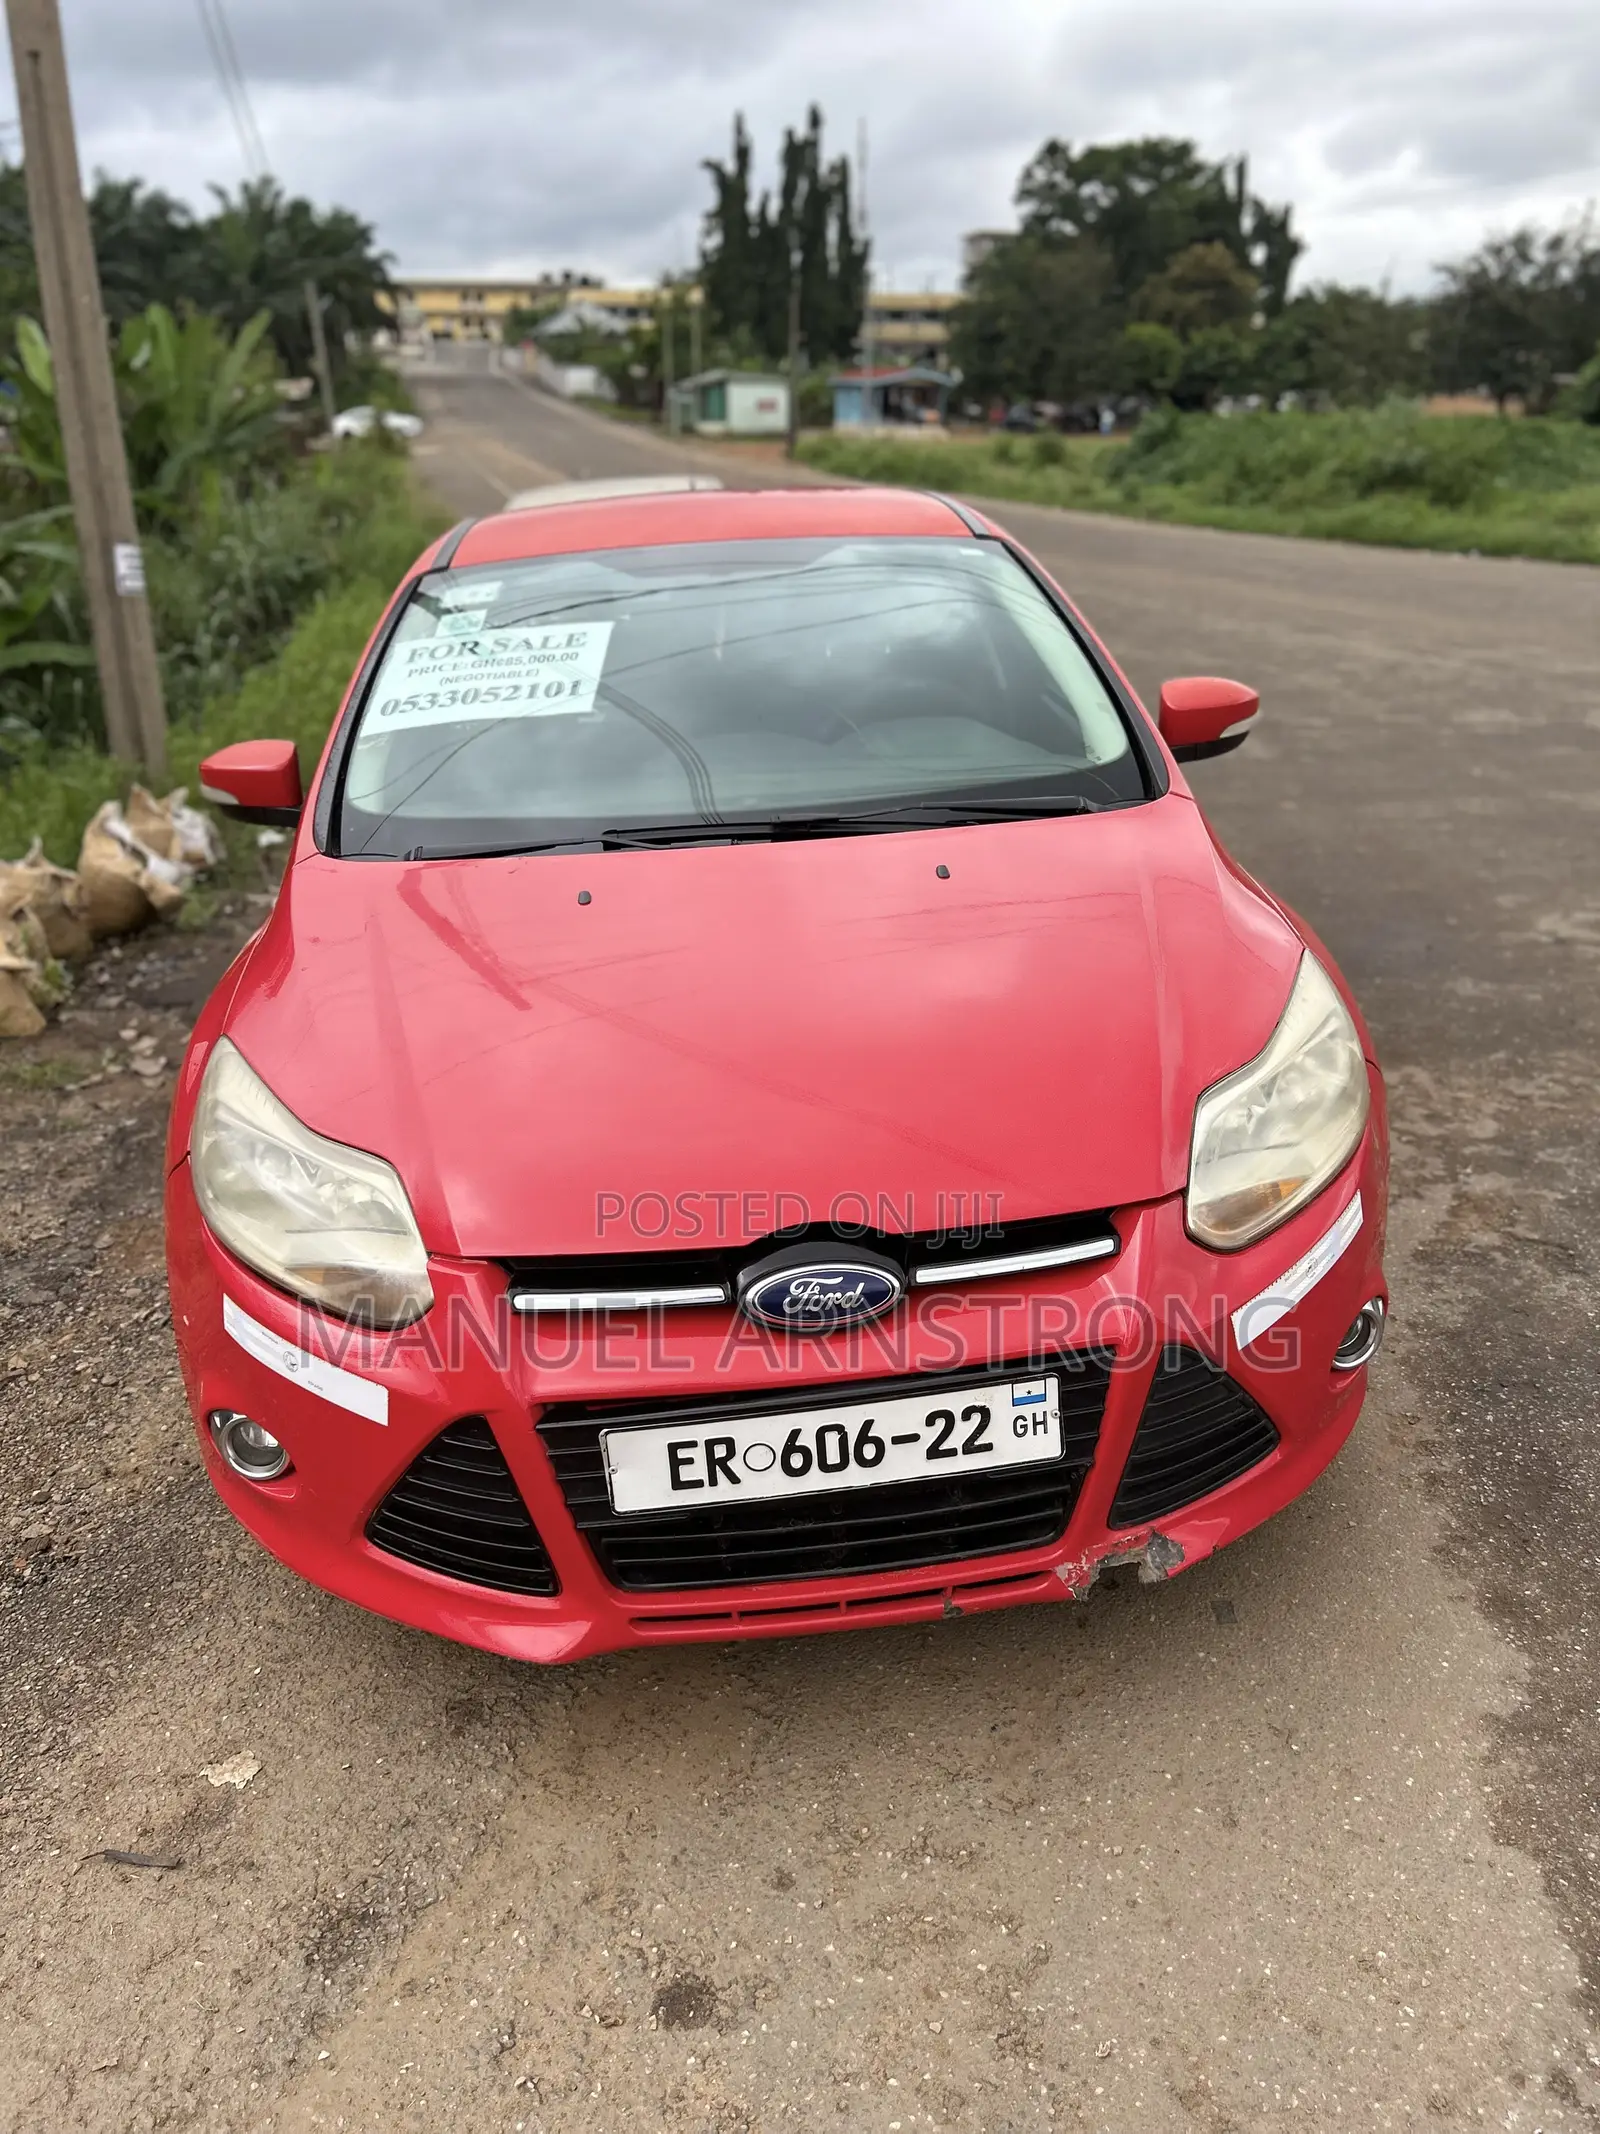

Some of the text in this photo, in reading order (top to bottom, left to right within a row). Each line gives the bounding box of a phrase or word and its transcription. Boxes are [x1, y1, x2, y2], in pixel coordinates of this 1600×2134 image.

[406, 631, 588, 664] FOR SALE
[439, 668, 541, 686] (NEGOTIABLE)
[380, 679, 583, 717] 0533052101
[783, 1276, 863, 1313] Ford
[1012, 1410, 1048, 1438] GH
